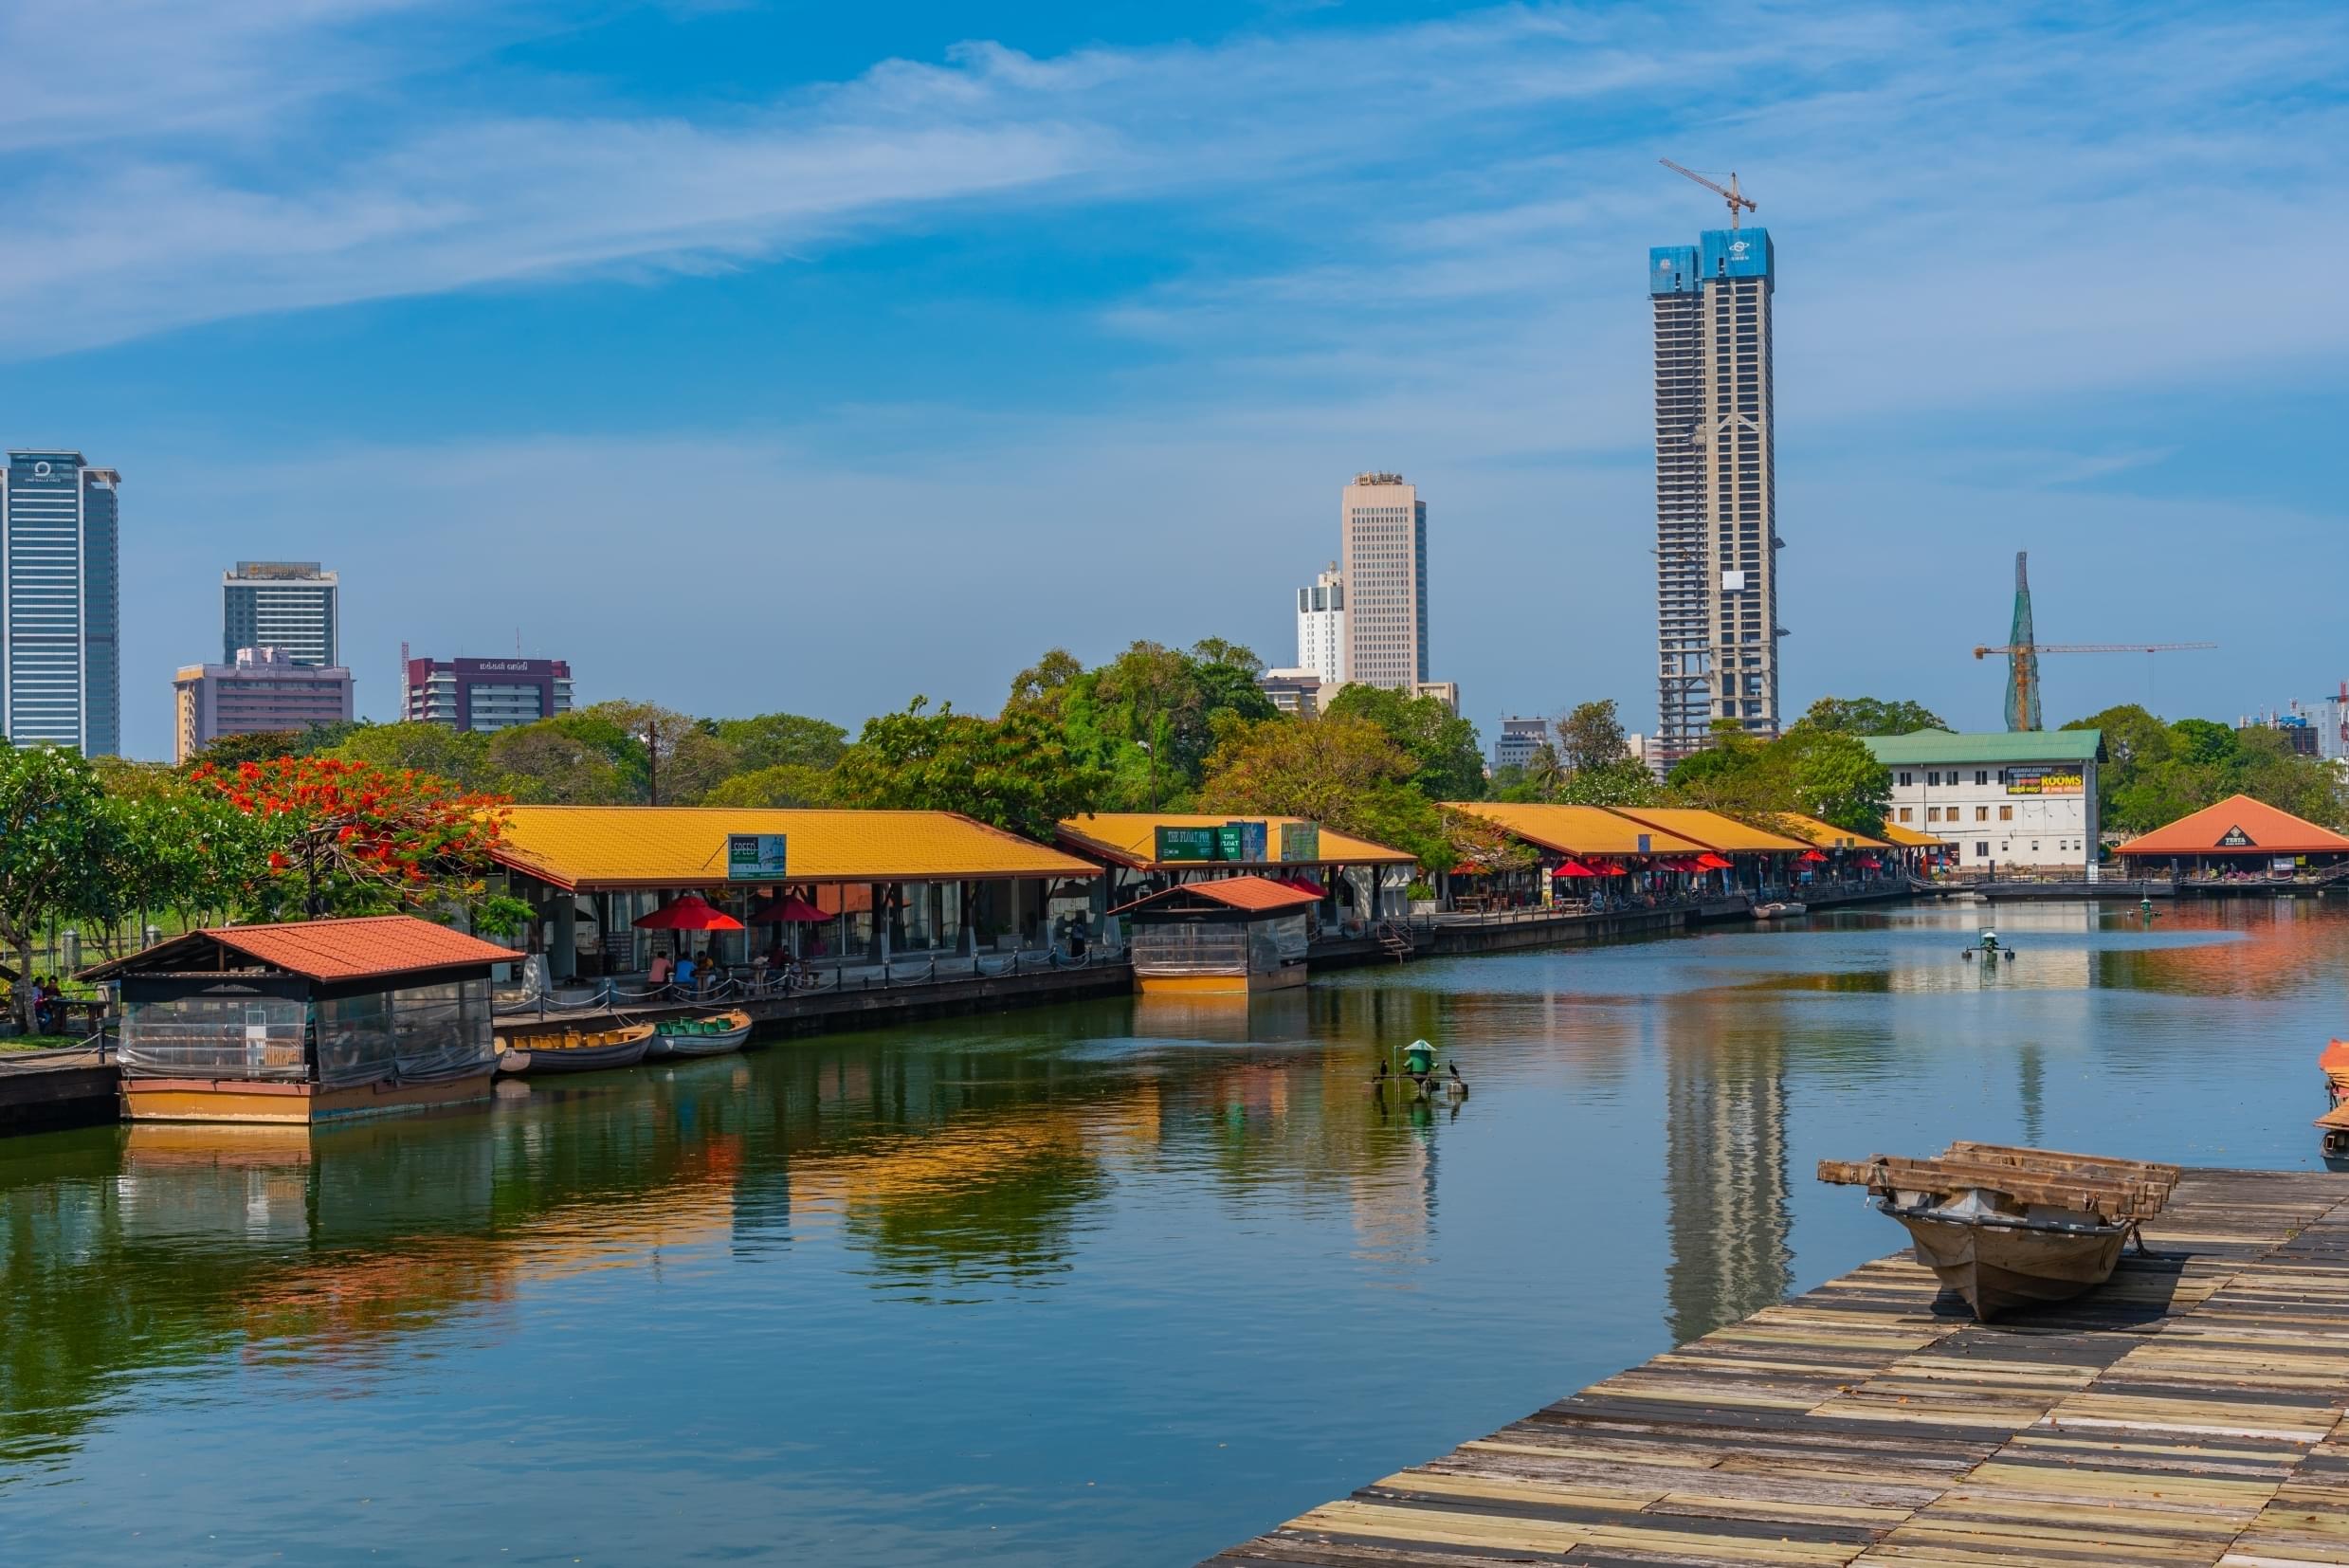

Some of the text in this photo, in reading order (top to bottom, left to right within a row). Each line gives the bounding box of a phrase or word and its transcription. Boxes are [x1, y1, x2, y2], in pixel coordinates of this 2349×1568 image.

[2042, 775, 2082, 786] ROOMS
[1167, 830, 1178, 843] THE
[1179, 830, 1198, 843] FLOAT
[734, 842, 756, 855] SPEED
